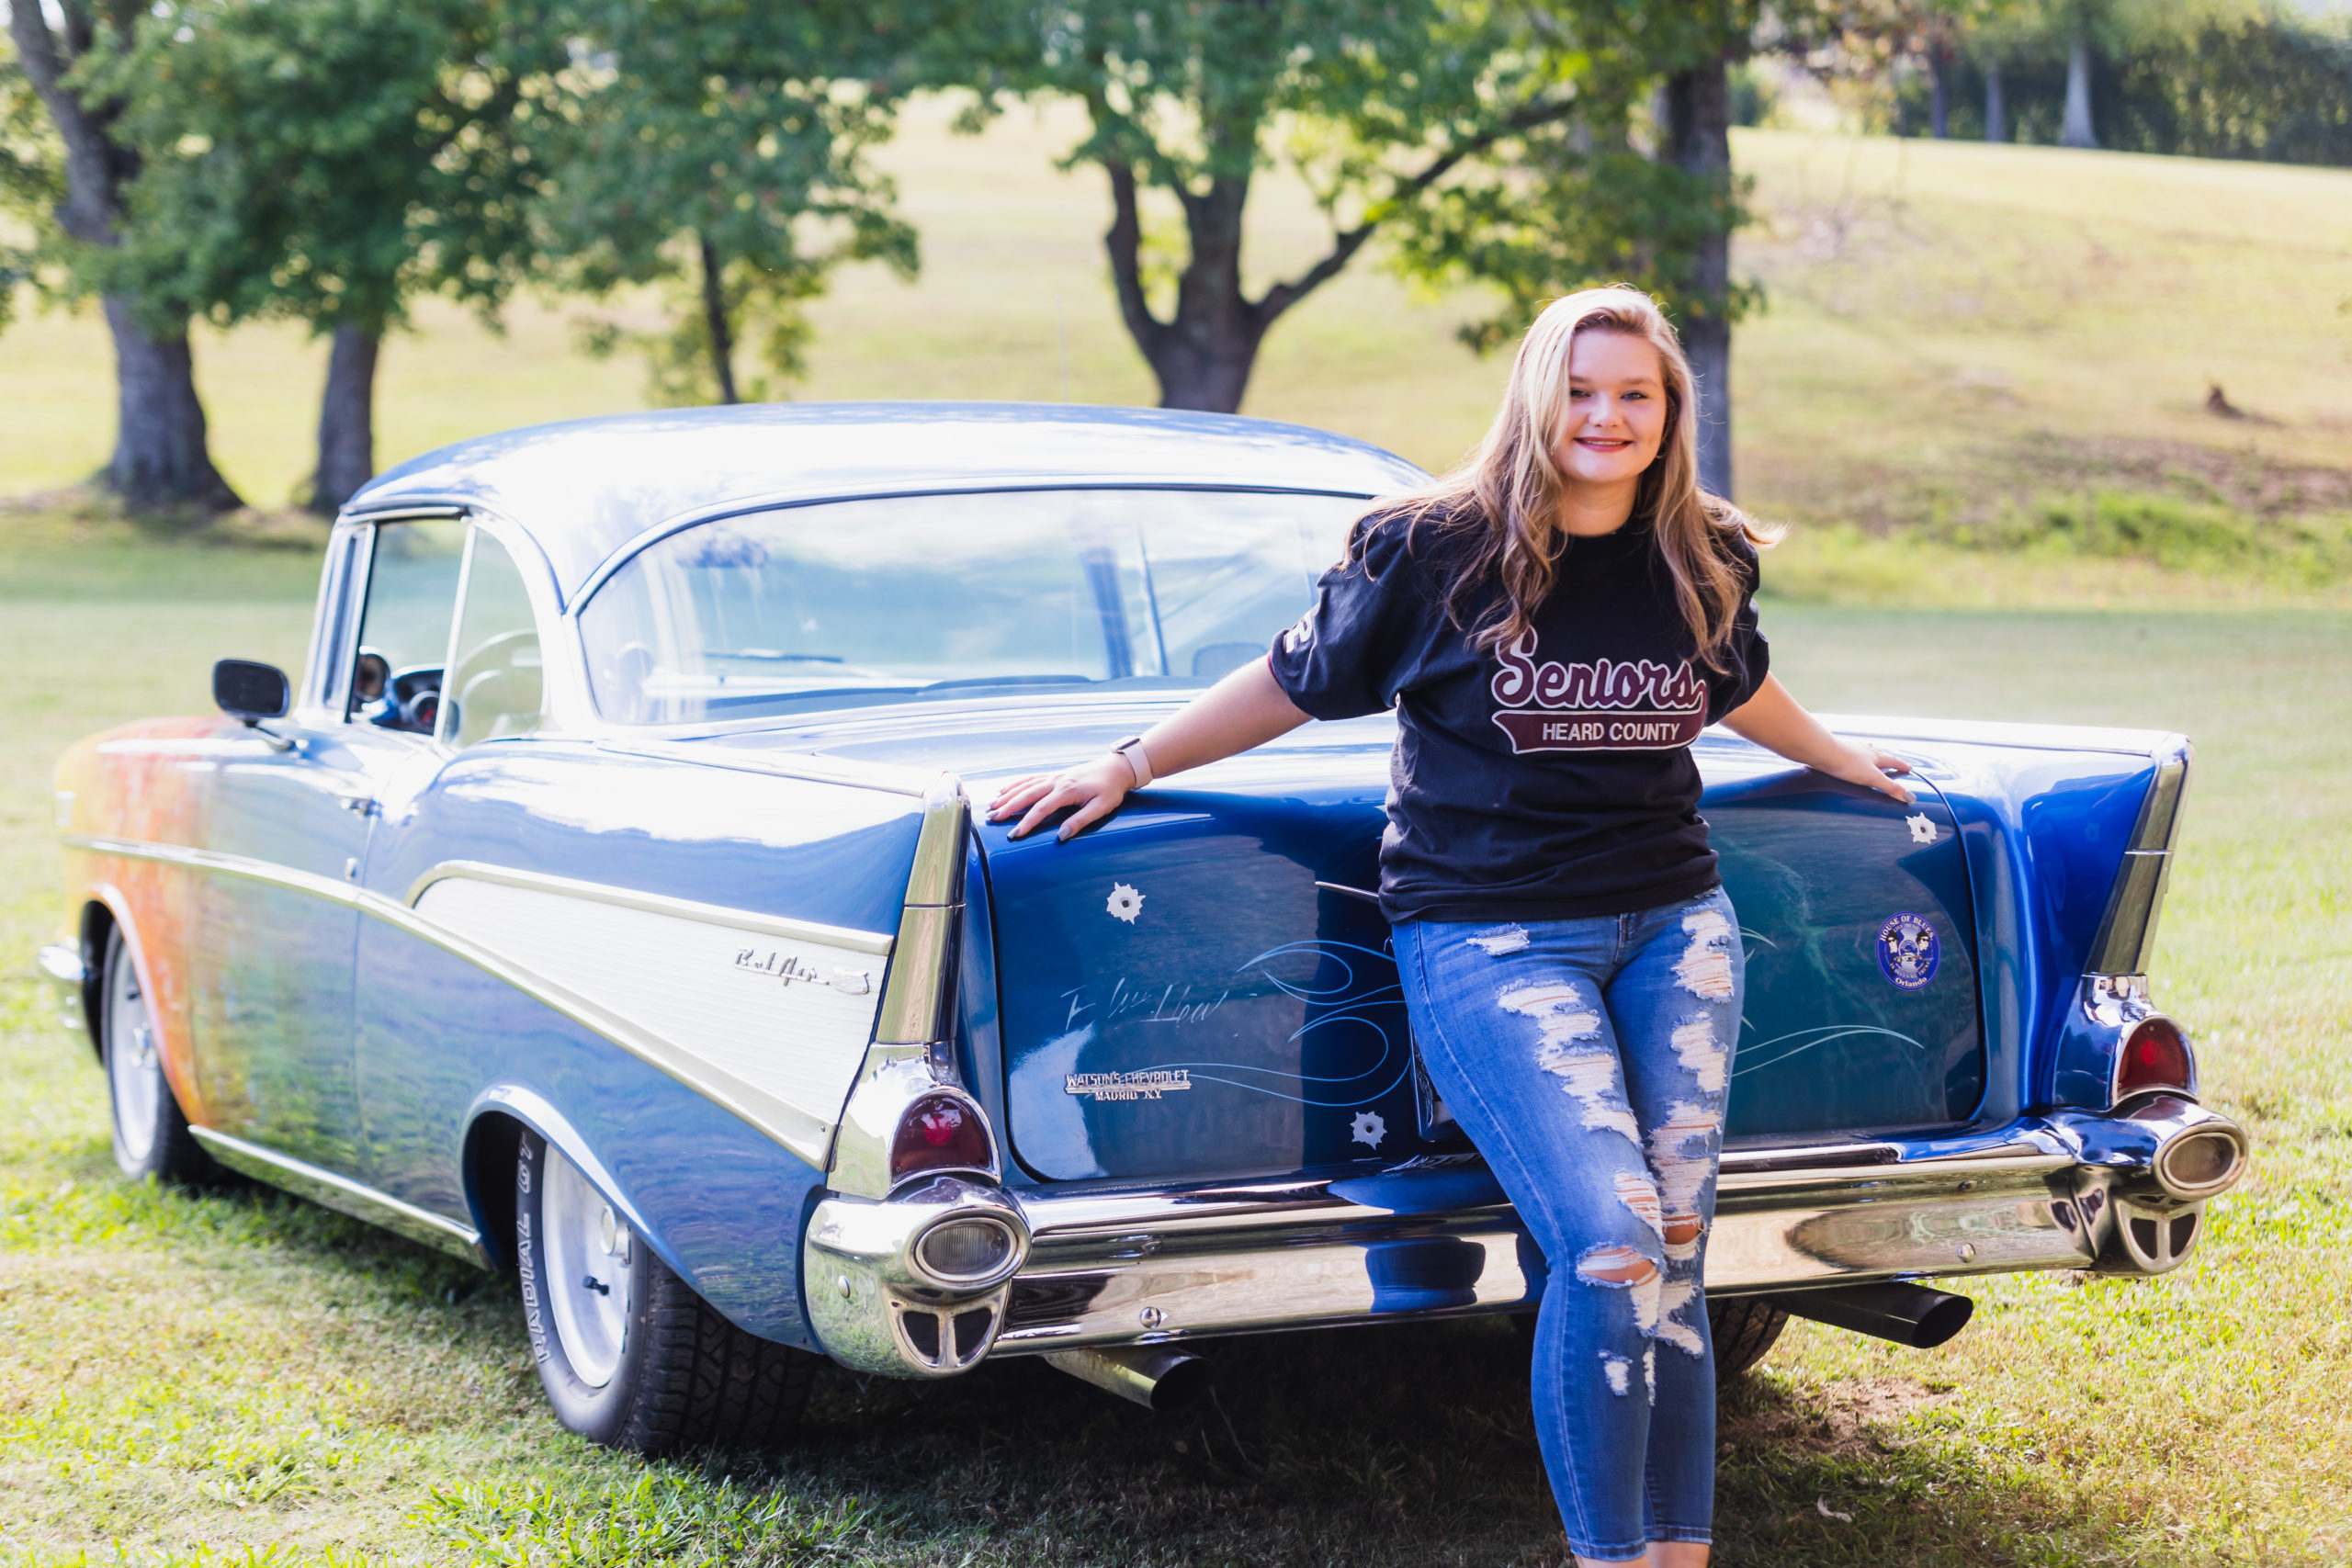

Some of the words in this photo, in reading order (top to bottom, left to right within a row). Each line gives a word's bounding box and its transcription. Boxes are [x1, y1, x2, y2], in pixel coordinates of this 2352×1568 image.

[1491, 626, 1705, 708] Seniors
[1543, 723, 1604, 740] HEARD
[1609, 723, 1680, 740] COUNTY
[1880, 918, 1900, 942] HOUSE
[1913, 917, 1934, 939] BLUES
[1895, 976, 1928, 987] Orlando
[1066, 1071, 1122, 1088] WATSON'S
[1125, 1070, 1189, 1085] CHEVROLET
[516, 1213, 551, 1364] RADIAL
